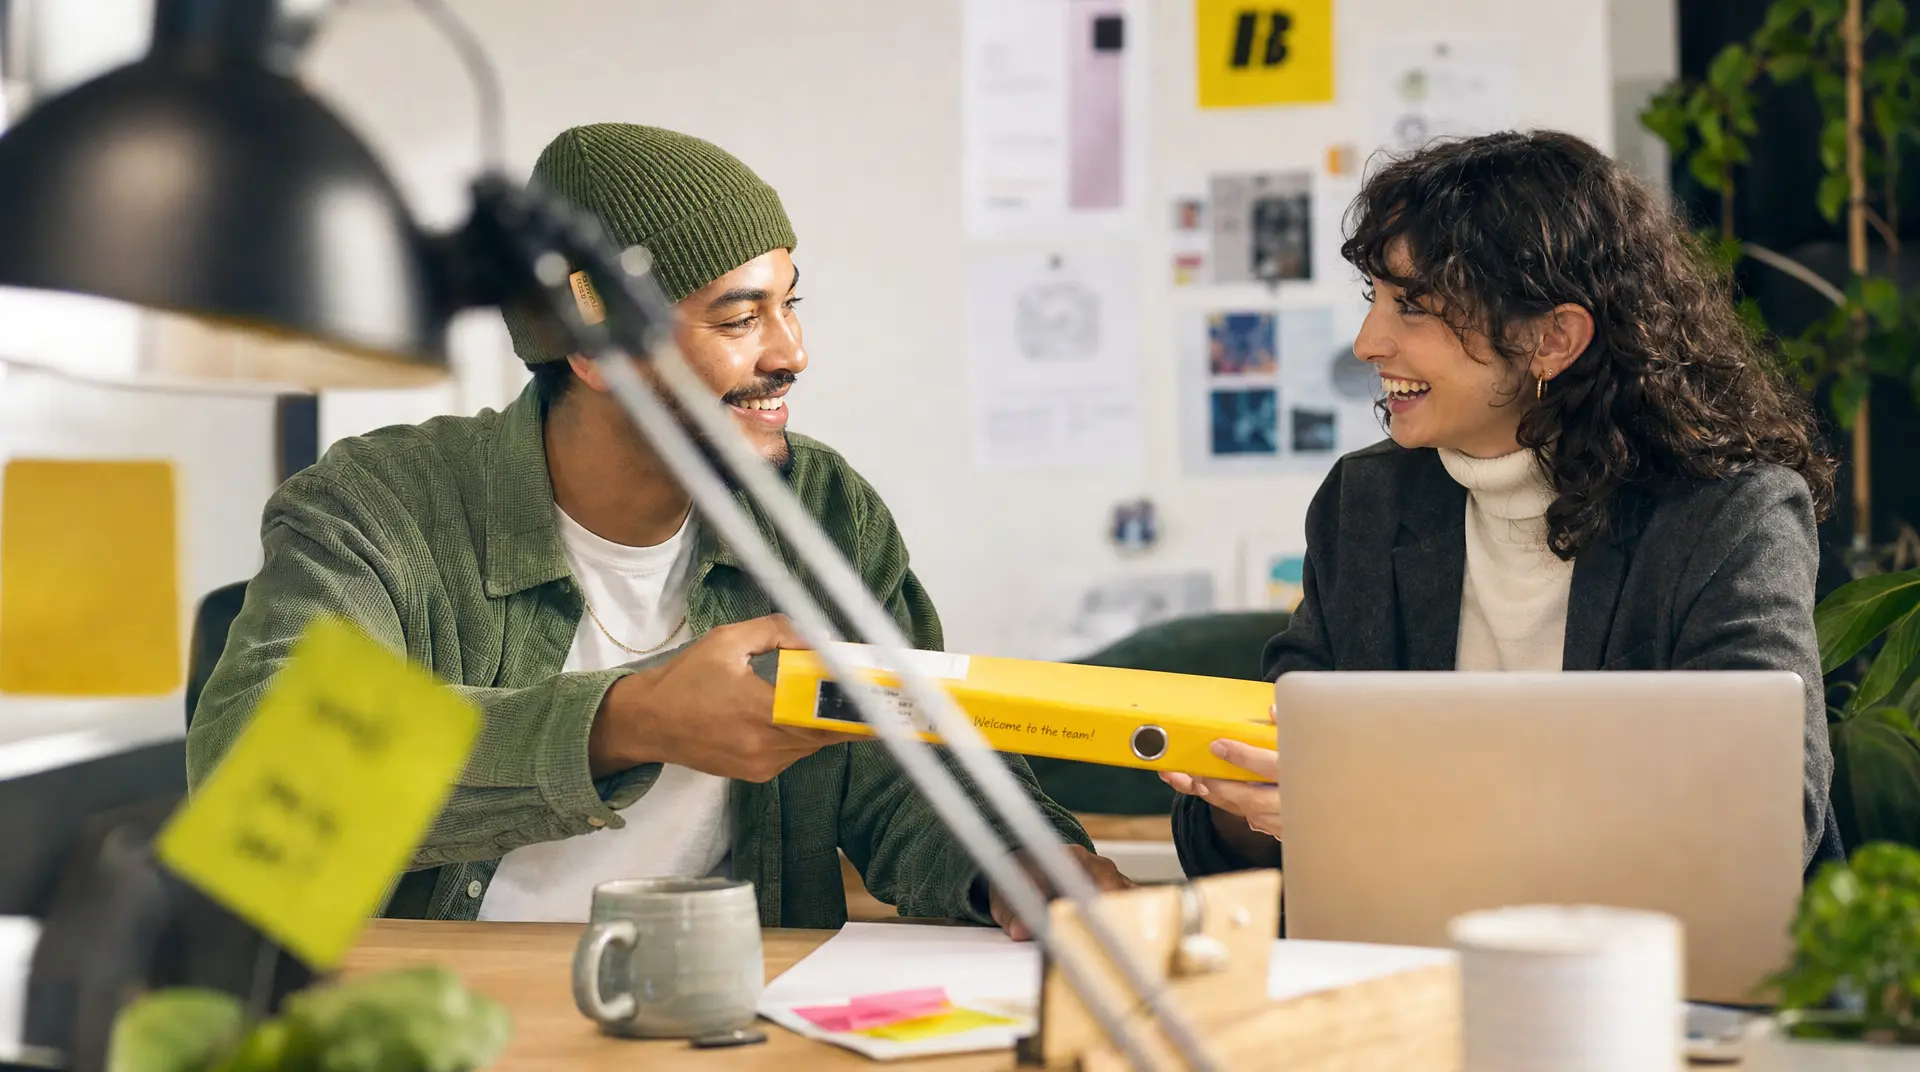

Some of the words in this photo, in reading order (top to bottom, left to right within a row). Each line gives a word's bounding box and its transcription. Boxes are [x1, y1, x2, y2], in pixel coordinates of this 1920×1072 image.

[973, 715, 1022, 732] Welcome
[1026, 722, 1038, 734] to
[1041, 724, 1058, 737] the
[1062, 727, 1096, 741] team!
